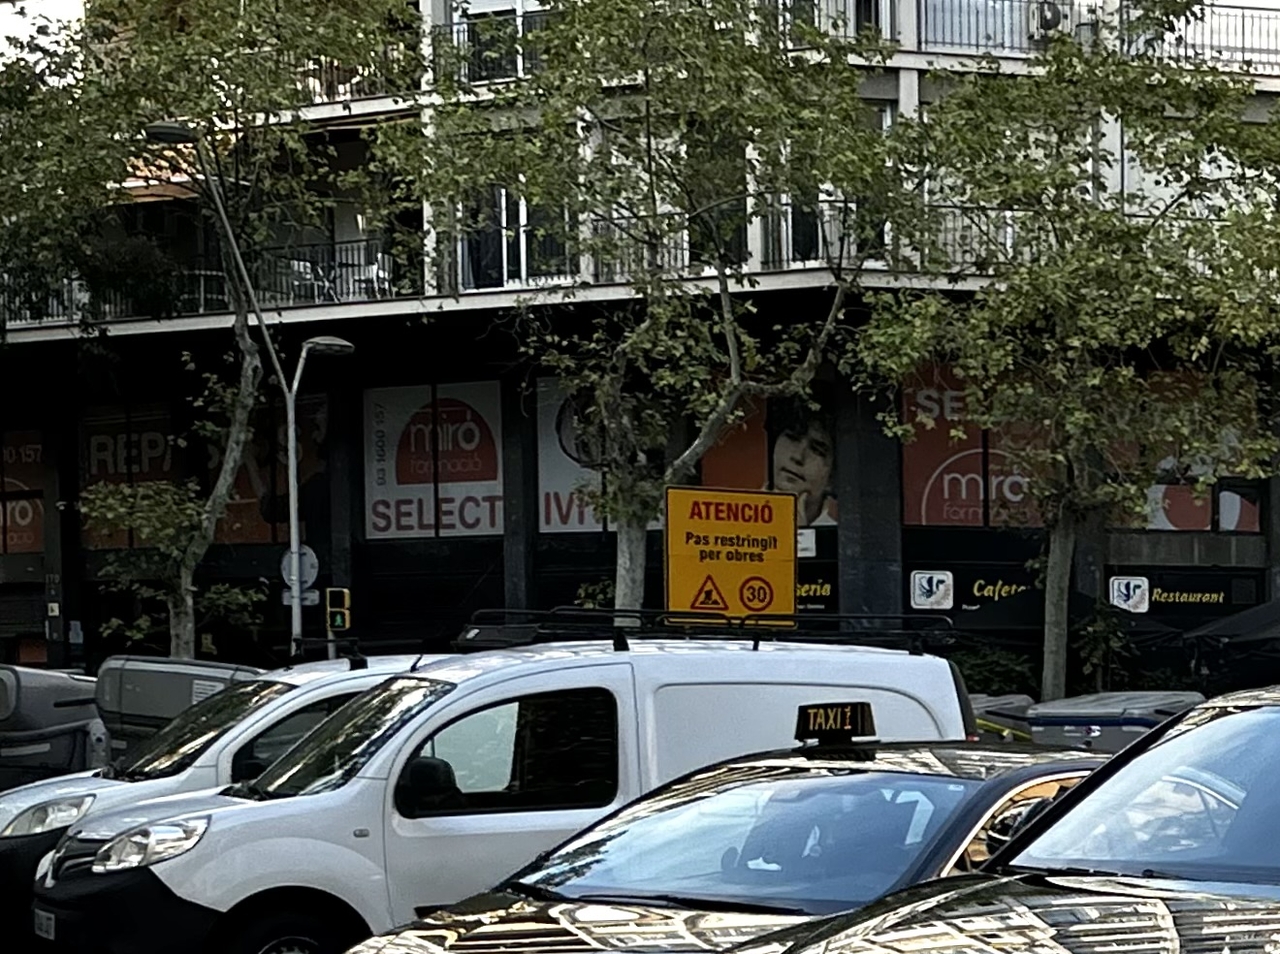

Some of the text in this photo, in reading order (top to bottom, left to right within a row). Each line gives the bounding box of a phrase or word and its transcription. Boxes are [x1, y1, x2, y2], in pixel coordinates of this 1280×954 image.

[371, 495, 503, 532] SELECT
[689, 500, 774, 524] ATENCIÓ
[685, 532, 778, 551] Pas restringit
[700, 550, 765, 562] per obres
[746, 586, 767, 603] 30
[1151, 587, 1225, 604] Restaurant
[807, 707, 841, 730] TAXI
